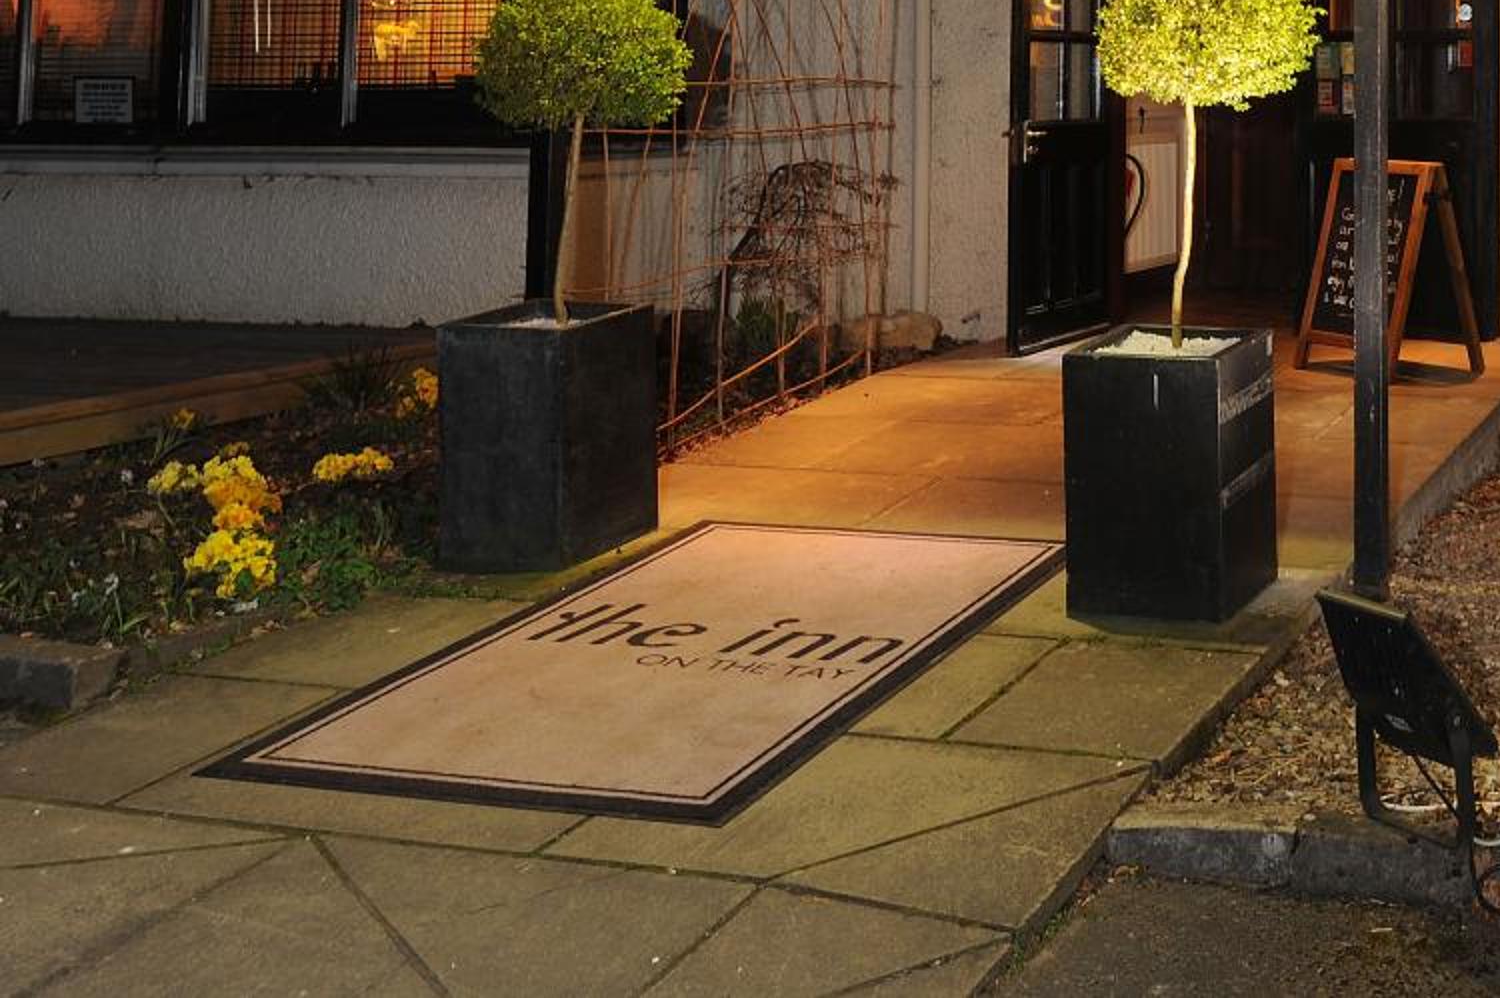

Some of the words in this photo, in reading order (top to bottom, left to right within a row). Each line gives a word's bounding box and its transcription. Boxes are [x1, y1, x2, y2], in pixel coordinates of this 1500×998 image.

[526, 603, 708, 648] the
[719, 618, 904, 664] inn
[635, 653, 700, 670] ON
[705, 658, 777, 676] THE
[784, 664, 856, 681] TAY
